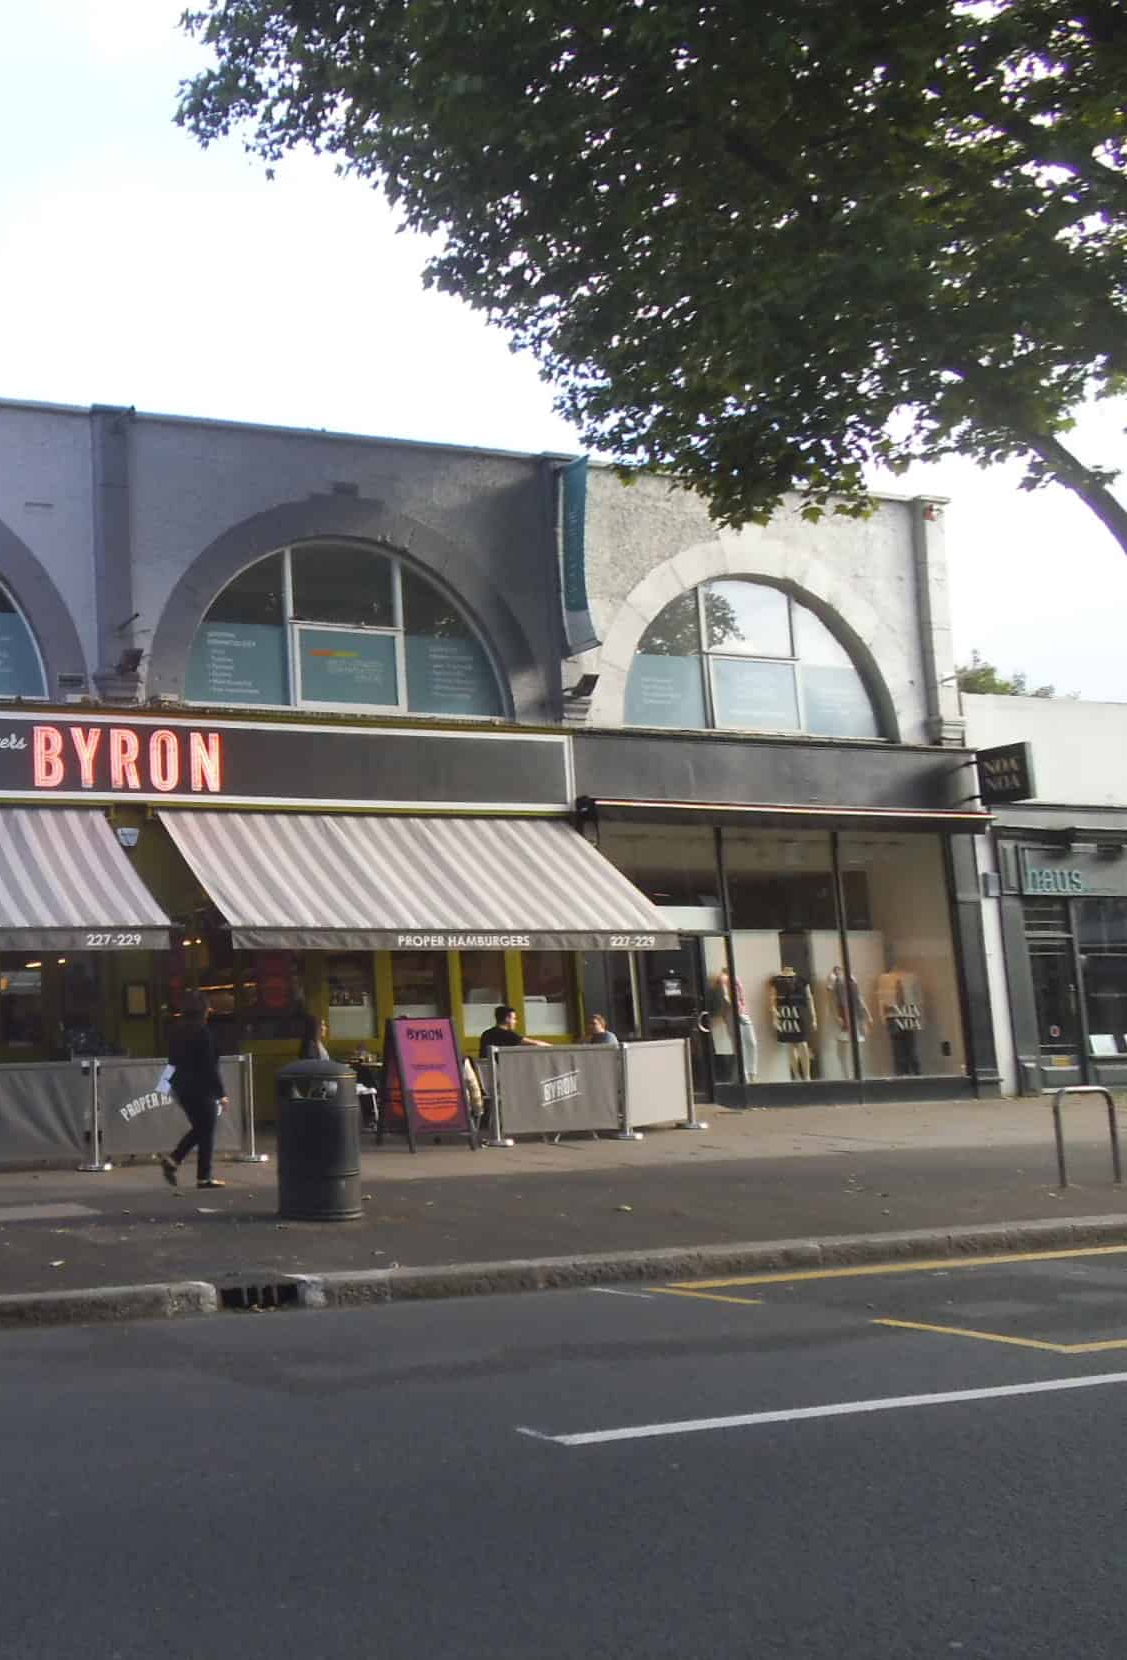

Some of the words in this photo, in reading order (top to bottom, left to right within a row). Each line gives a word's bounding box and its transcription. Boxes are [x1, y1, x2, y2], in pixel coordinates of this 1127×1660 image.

[32, 725, 222, 792] BYRON
[86, 933, 142, 946] 227-229
[397, 935, 445, 947] PROPER
[448, 936, 530, 947] HAMBURGERS
[610, 936, 655, 947] 227-229
[407, 1028, 444, 1041] BYRON
[543, 1074, 577, 1101] BYRON
[119, 1092, 161, 1122] PROPER
